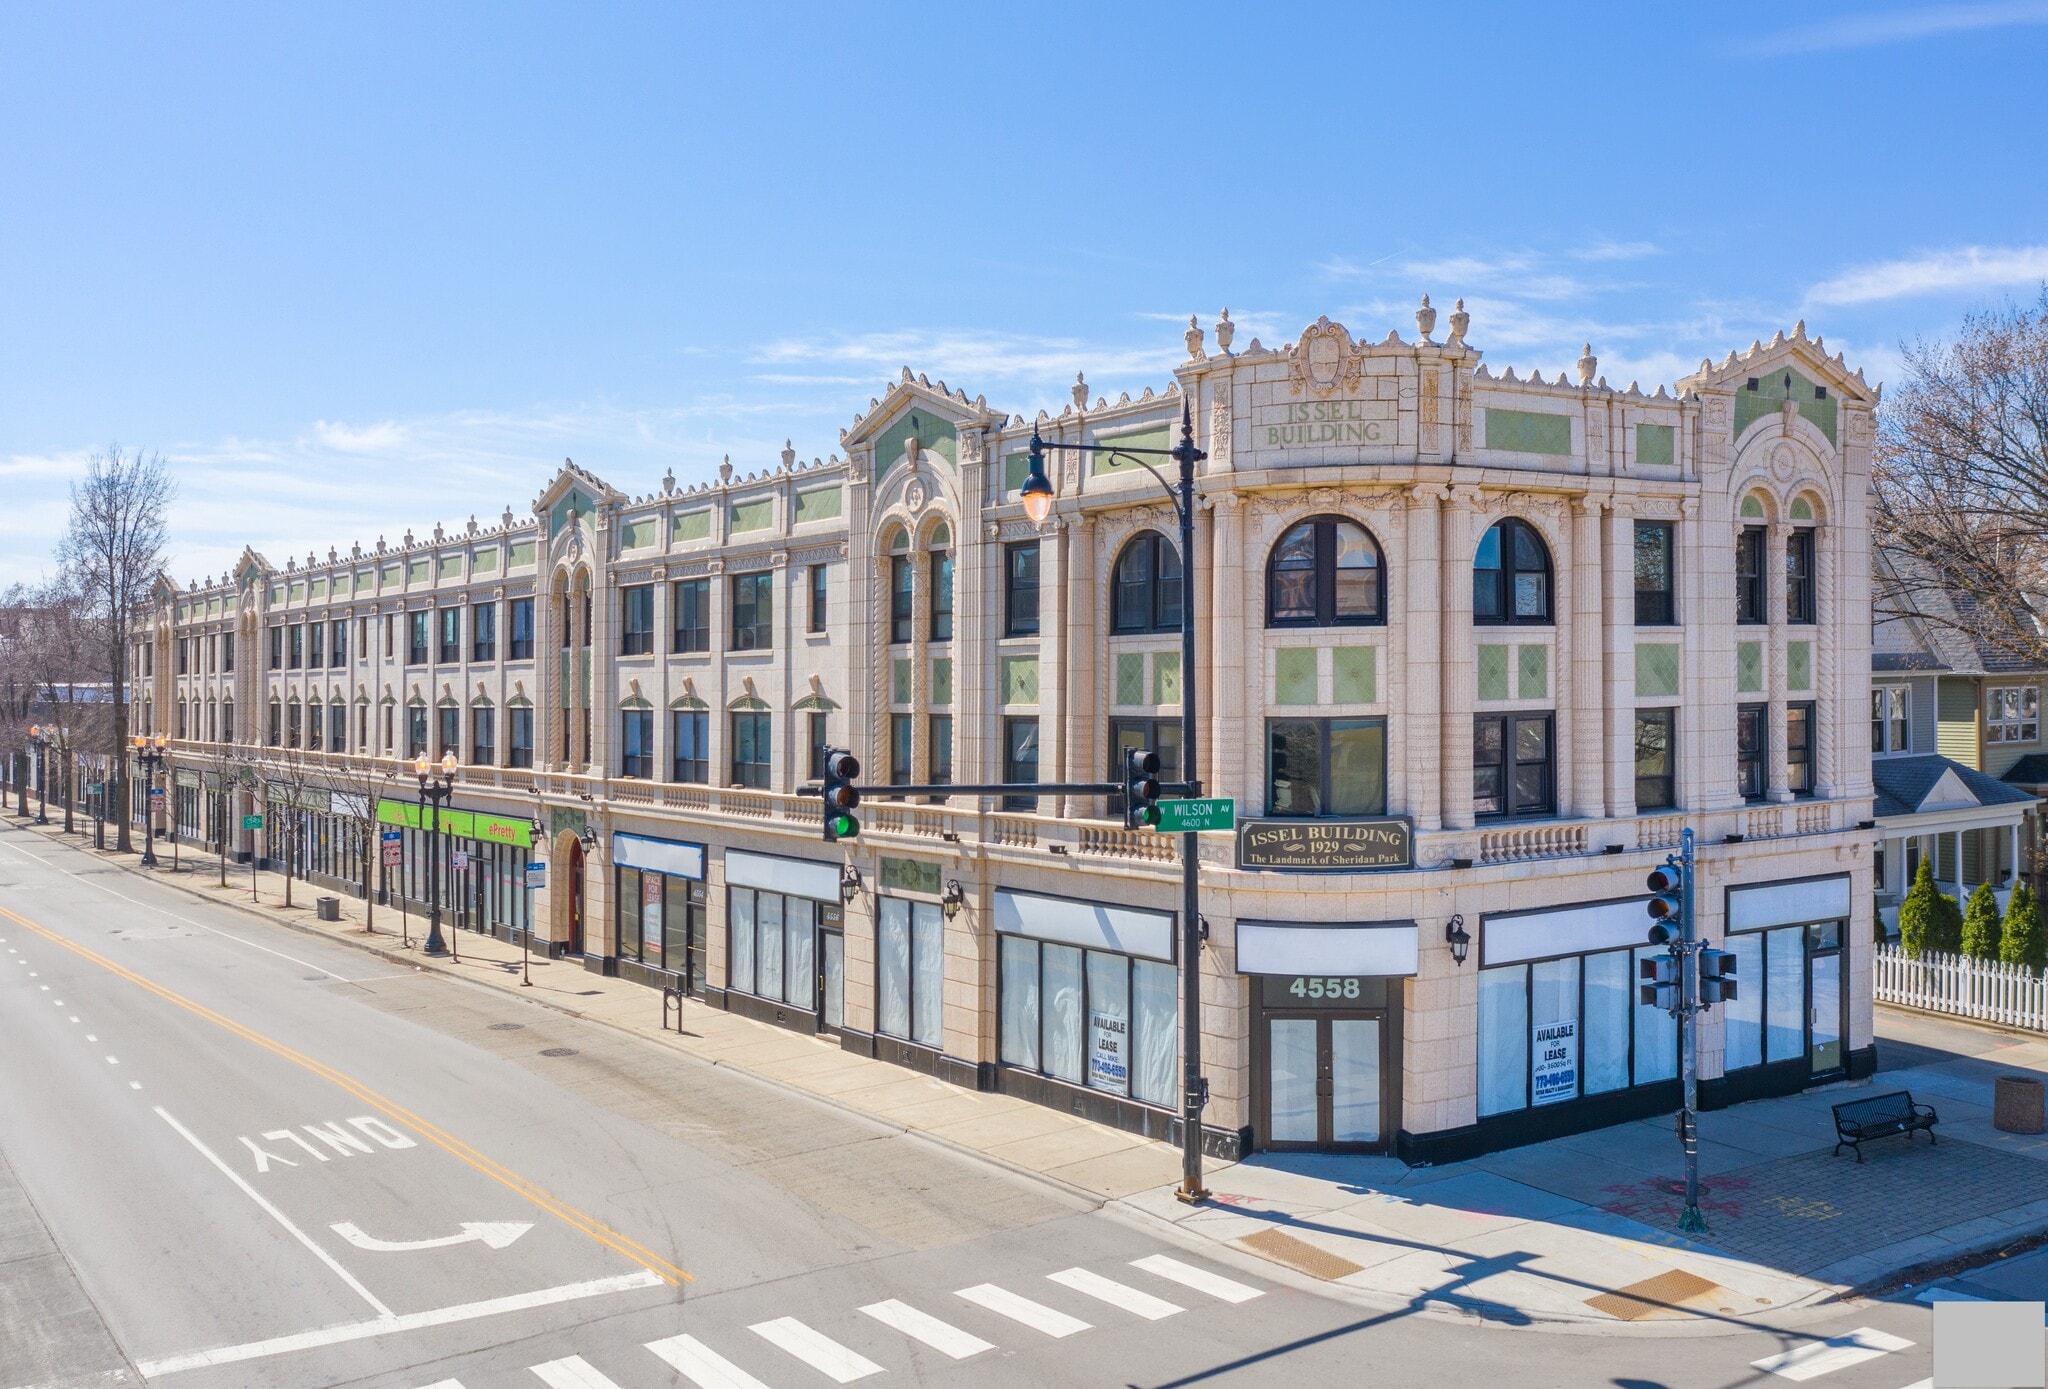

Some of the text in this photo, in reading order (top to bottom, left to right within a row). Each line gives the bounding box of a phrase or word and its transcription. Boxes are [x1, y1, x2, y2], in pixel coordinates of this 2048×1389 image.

[1287, 401, 1361, 422] ISSEL
[1268, 422, 1380, 446] BUILDING
[1159, 803, 1230, 816] W WILSON AV
[1181, 818, 1210, 827] 4600 N
[488, 823, 516, 842] ePretty
[1250, 826, 1401, 847] ISSEL BUILDING
[1309, 841, 1340, 853] 1929
[1250, 853, 1400, 865] The Landmark of Sheridan Park
[1289, 977, 1360, 999] 4558
[1093, 1015, 1126, 1035] AVAILABLE
[1536, 1024, 1574, 1042] AVAILABLE
[1103, 1031, 1112, 1039] FOR
[1098, 1038, 1118, 1053] LEASE
[1096, 1051, 1107, 1061] CALL
[1544, 1047, 1567, 1061] LEASE
[237, 1115, 419, 1173] ONLY
